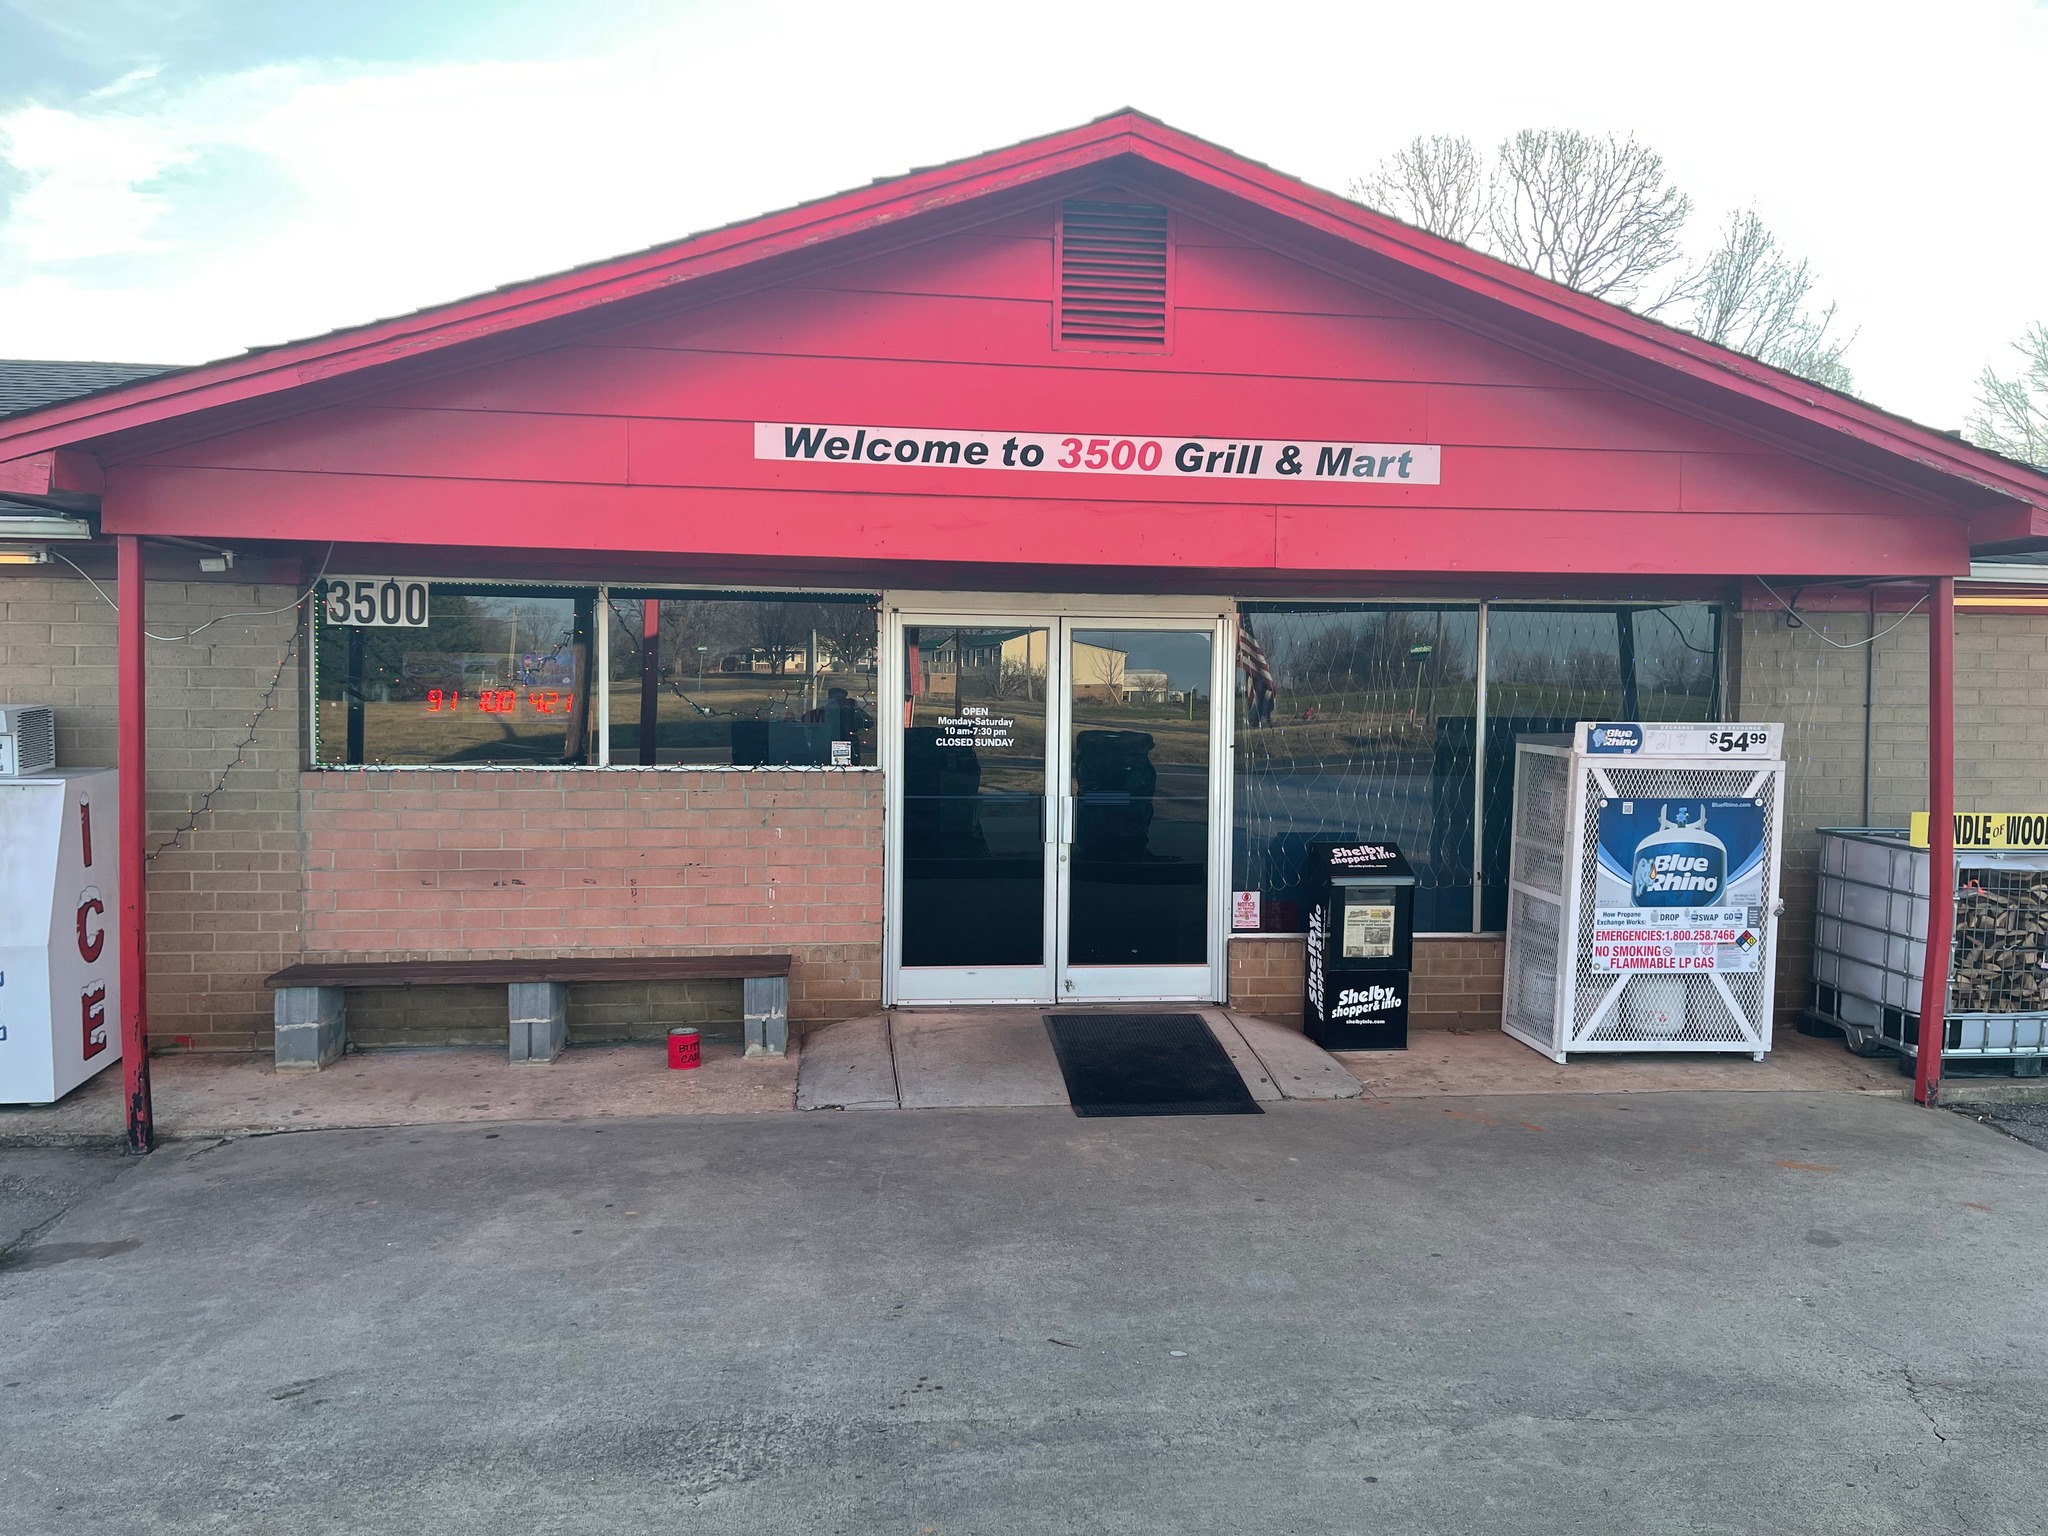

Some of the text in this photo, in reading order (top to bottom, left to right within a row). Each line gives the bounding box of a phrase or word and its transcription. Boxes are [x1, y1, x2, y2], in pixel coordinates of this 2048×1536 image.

[785, 427, 1413, 479] Welcome to 3500 Grill & Mart
[329, 581, 426, 625] 3500
[529, 691, 573, 714] 421
[962, 707, 989, 716] OPEN
[938, 717, 1013, 728] Monday-Saturday
[944, 727, 956, 735] 10
[993, 729, 1007, 737] pm
[1603, 729, 1638, 747] Blue Rhino
[936, 738, 1014, 747] CLOSED SUNDAY
[2006, 815, 2048, 845] WOO
[1332, 845, 1385, 858] Shelby
[1377, 851, 1397, 860] info
[1654, 854, 1709, 872] Blue
[1646, 872, 1718, 892] Rhino
[1597, 919, 1625, 927] Exchange
[1617, 911, 1642, 919] Propane
[1723, 913, 1734, 921] GO
[77, 791, 107, 1061] ICE
[1307, 912, 1318, 1005] Shelby
[1595, 945, 1609, 957] NO
[1612, 945, 1661, 957] SMOKING
[1610, 957, 1715, 969] FLAMMABLE LP GAS
[1338, 985, 1395, 1006] Shelby
[1381, 995, 1402, 1010] info
